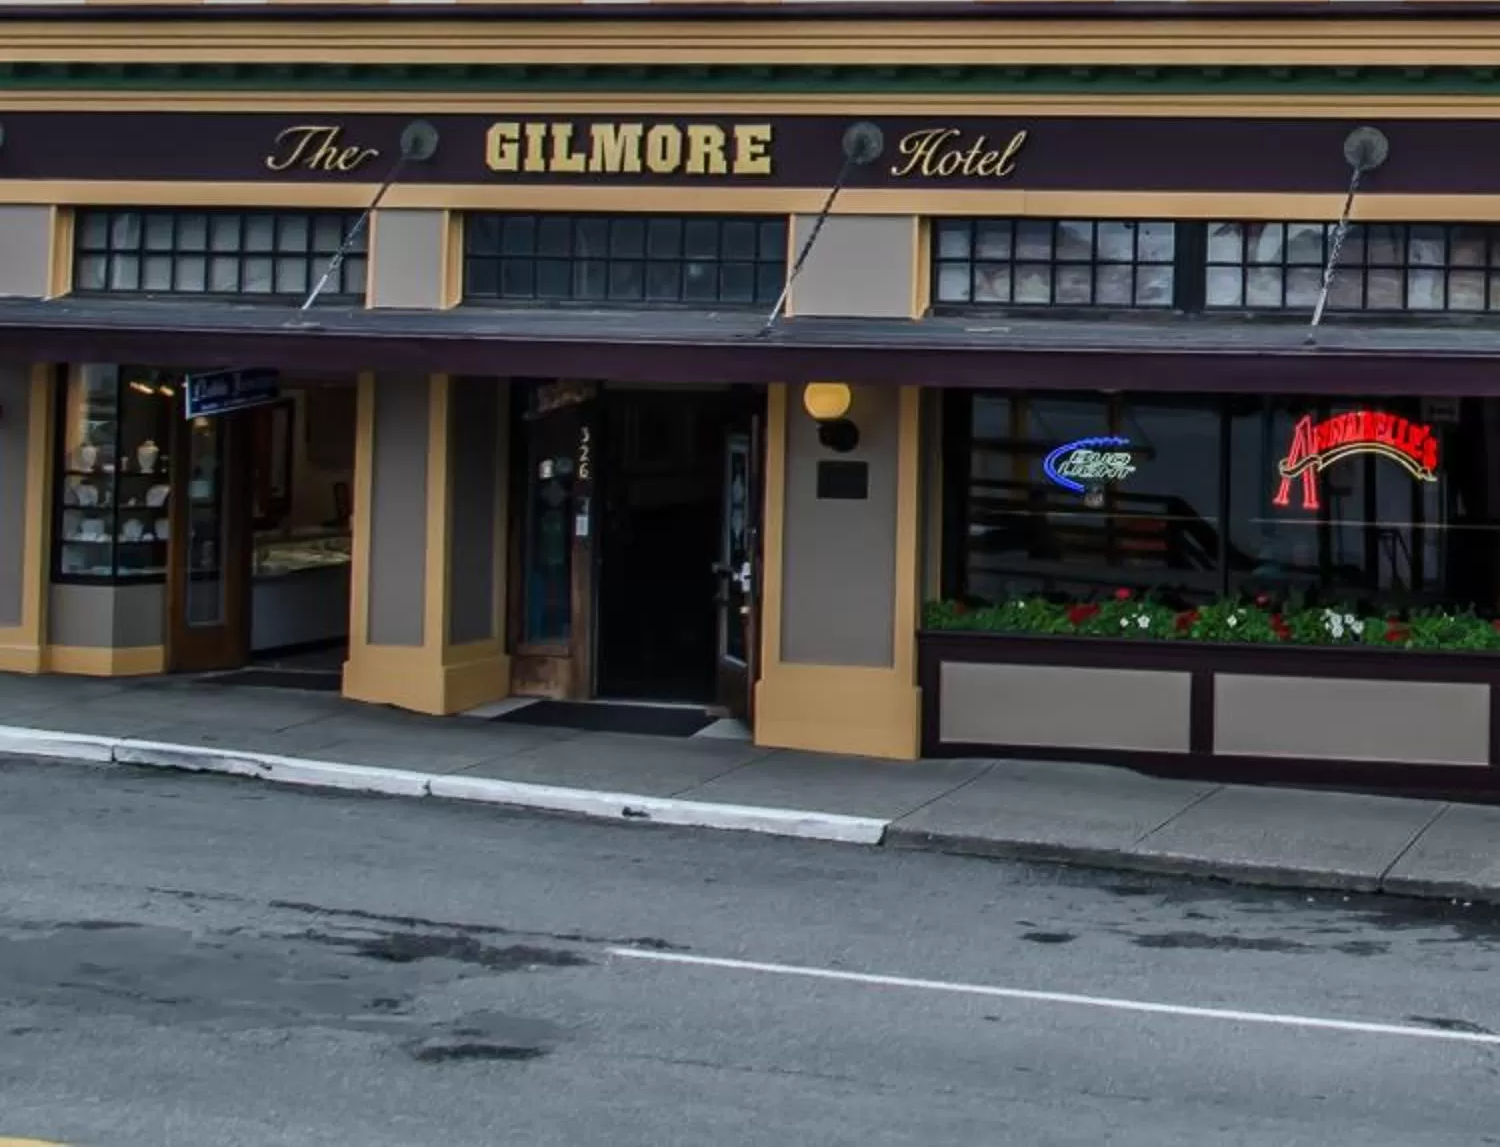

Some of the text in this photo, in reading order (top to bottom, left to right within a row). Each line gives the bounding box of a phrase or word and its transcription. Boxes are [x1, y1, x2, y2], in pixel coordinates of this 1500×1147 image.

[266, 122, 1028, 176] The GILMORE Hotel
